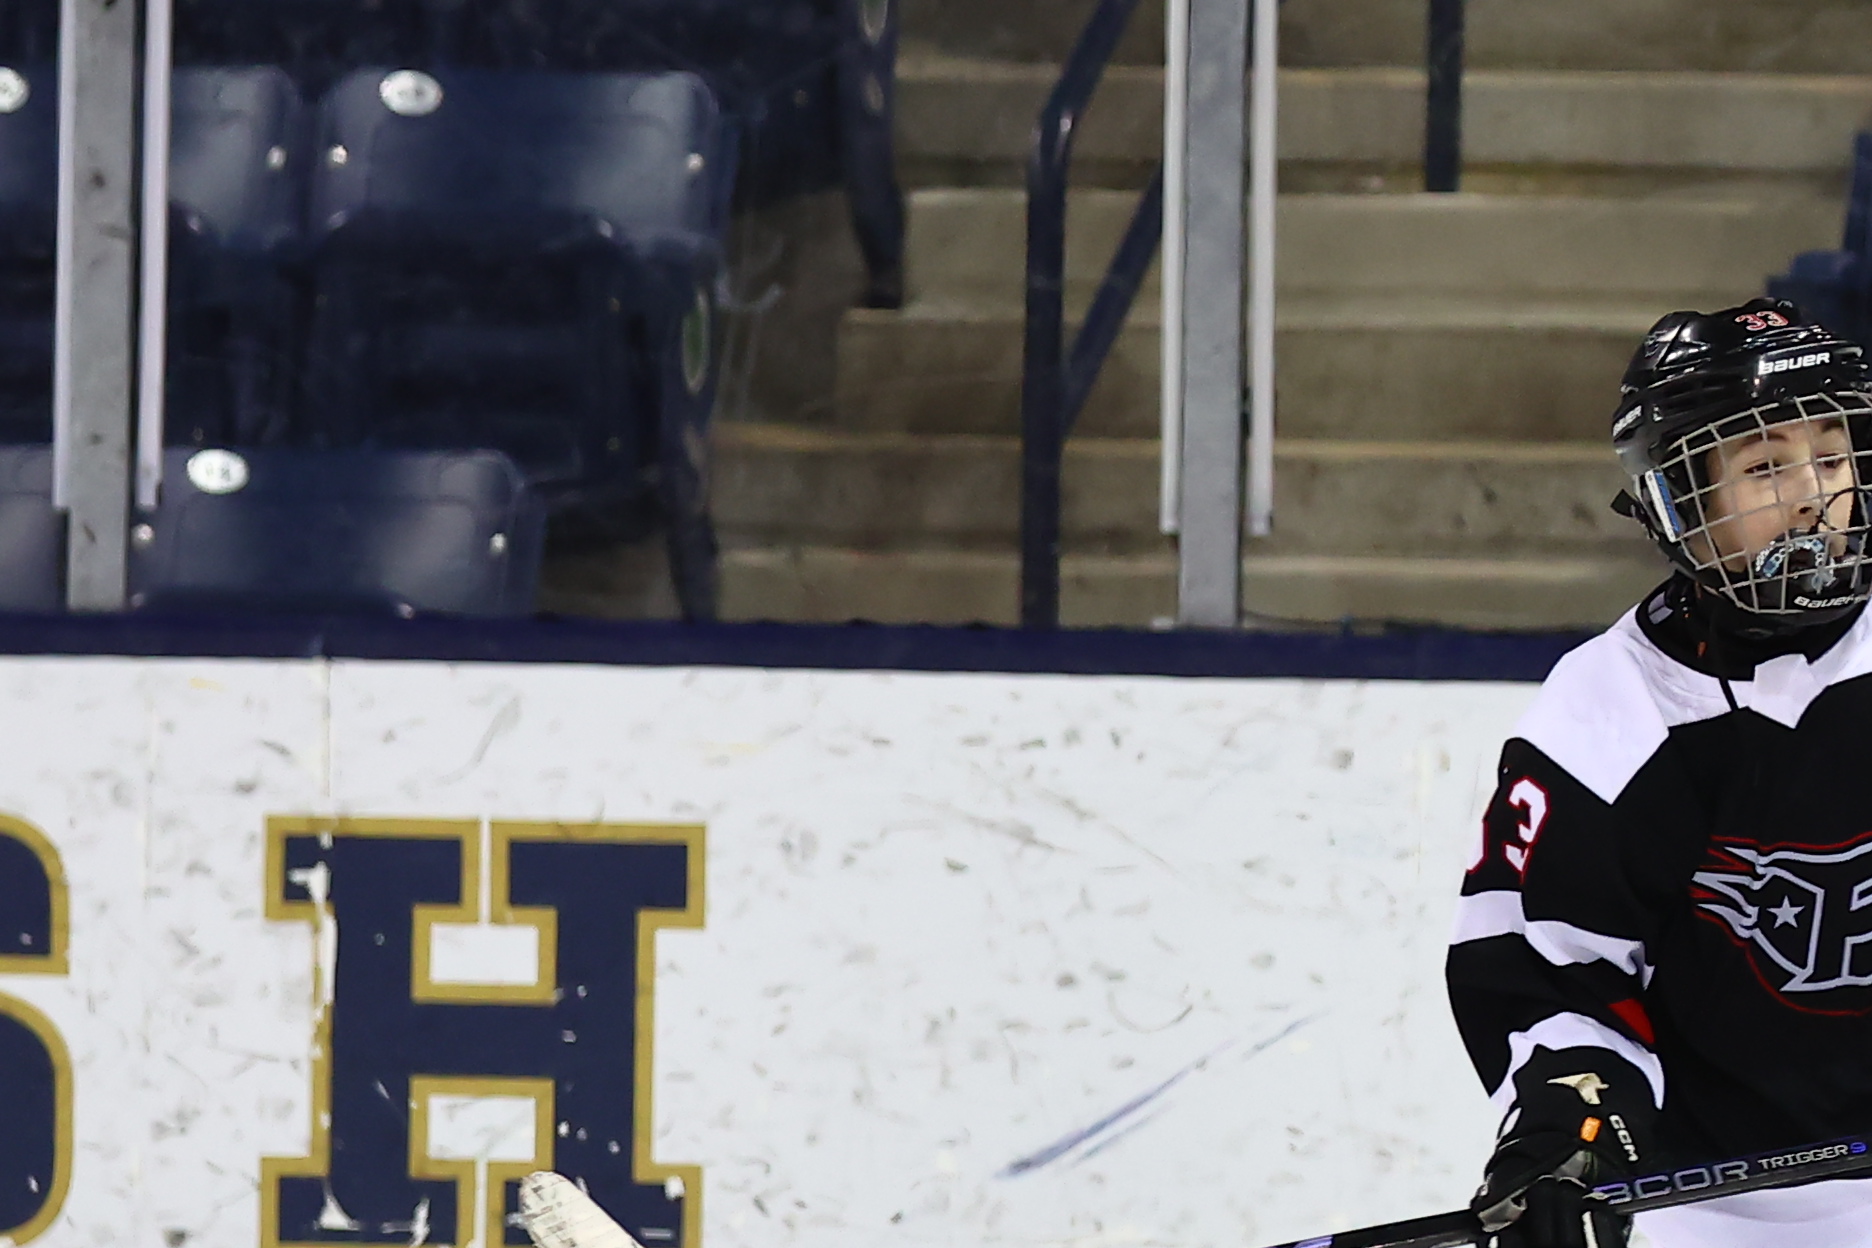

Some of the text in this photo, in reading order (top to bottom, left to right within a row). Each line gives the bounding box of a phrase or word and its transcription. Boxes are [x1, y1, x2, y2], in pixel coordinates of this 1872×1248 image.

[1735, 311, 1788, 331] 33
[1757, 350, 1831, 376] BAUER
[1465, 774, 1551, 884] 3
